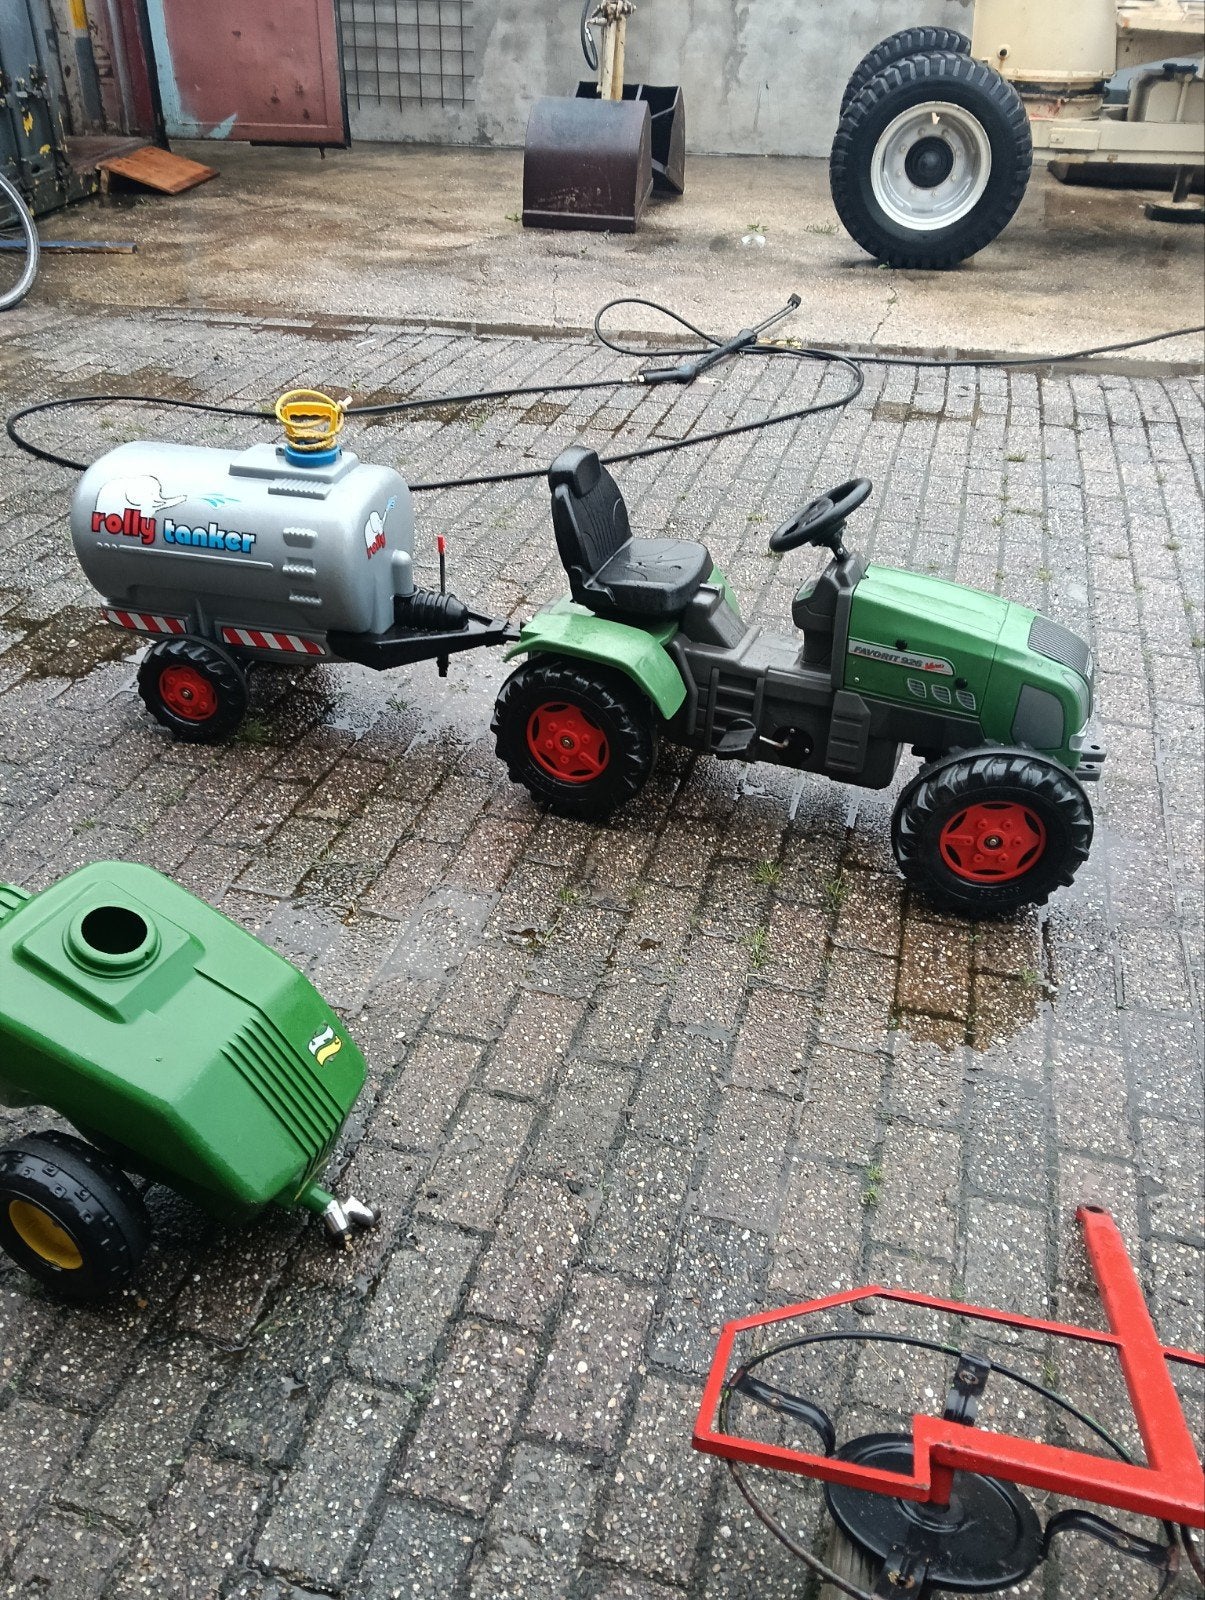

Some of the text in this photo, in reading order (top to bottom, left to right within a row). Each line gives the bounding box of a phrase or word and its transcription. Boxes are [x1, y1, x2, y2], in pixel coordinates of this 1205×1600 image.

[92, 508, 257, 554] rolly tanker
[853, 646, 900, 662] FAVORIT
